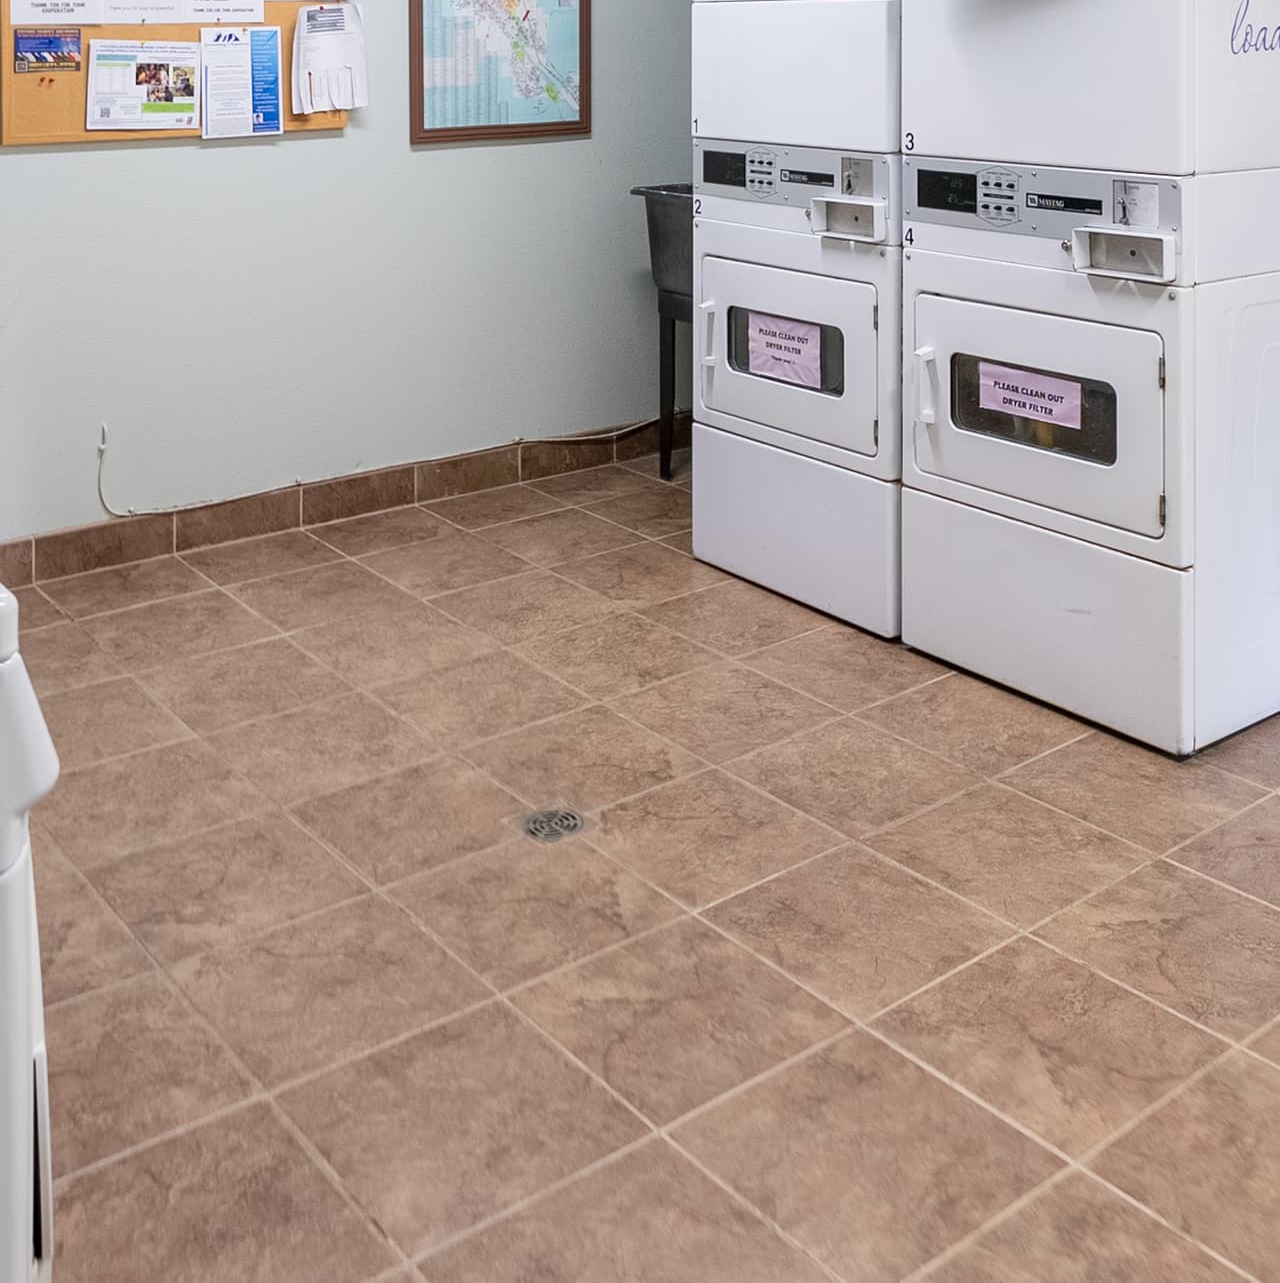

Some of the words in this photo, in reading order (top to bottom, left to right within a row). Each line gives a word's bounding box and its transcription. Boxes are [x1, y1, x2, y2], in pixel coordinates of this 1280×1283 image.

[693, 118, 699, 133] 1
[905, 132, 915, 151] 3
[694, 198, 702, 215] 2
[1038, 197, 1065, 207] MAYTAG
[904, 227, 914, 246] 4
[759, 328, 777, 337] PLEASE
[778, 332, 796, 341] CLEAN
[797, 336, 808, 344] OUT
[766, 342, 782, 350] DRYER
[784, 346, 801, 355] FILTER
[993, 380, 1020, 393] PLEASE
[1021, 387, 1045, 399] CLEAN
[1047, 394, 1064, 404] OUT
[1003, 397, 1027, 409] DRYER
[1029, 404, 1053, 415] FILTER
